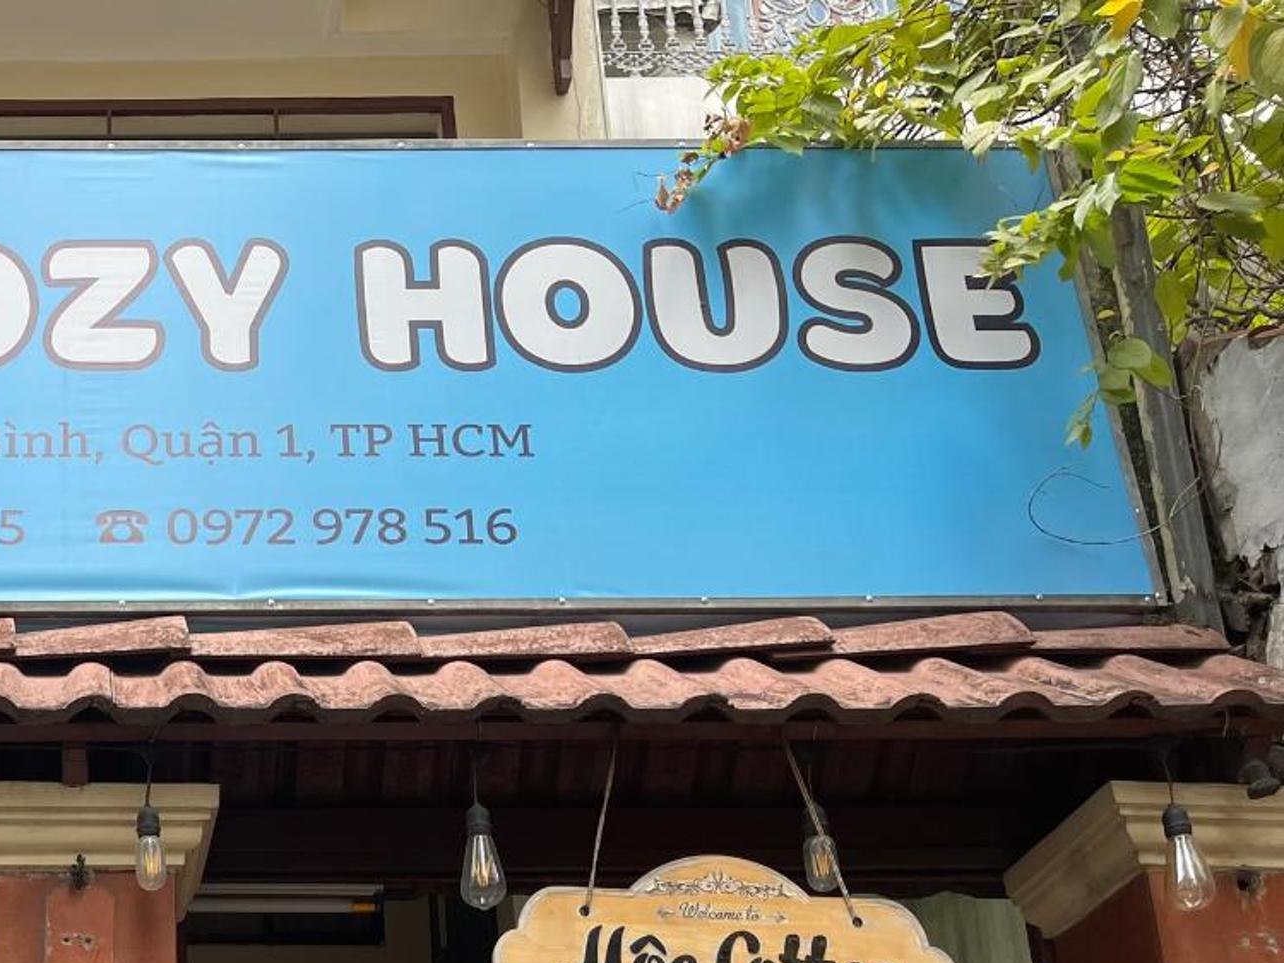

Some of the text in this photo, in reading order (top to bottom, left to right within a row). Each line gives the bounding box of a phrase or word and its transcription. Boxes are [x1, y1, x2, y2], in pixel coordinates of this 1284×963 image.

[354, 236, 1041, 373] HOUSE
[121, 422, 259, 466] Quận
[278, 423, 316, 464] 1,
[330, 423, 393, 458] TP
[409, 423, 535, 458] HCM
[167, 507, 295, 546] 0972
[313, 507, 408, 546] 978
[423, 507, 517, 546] 516
